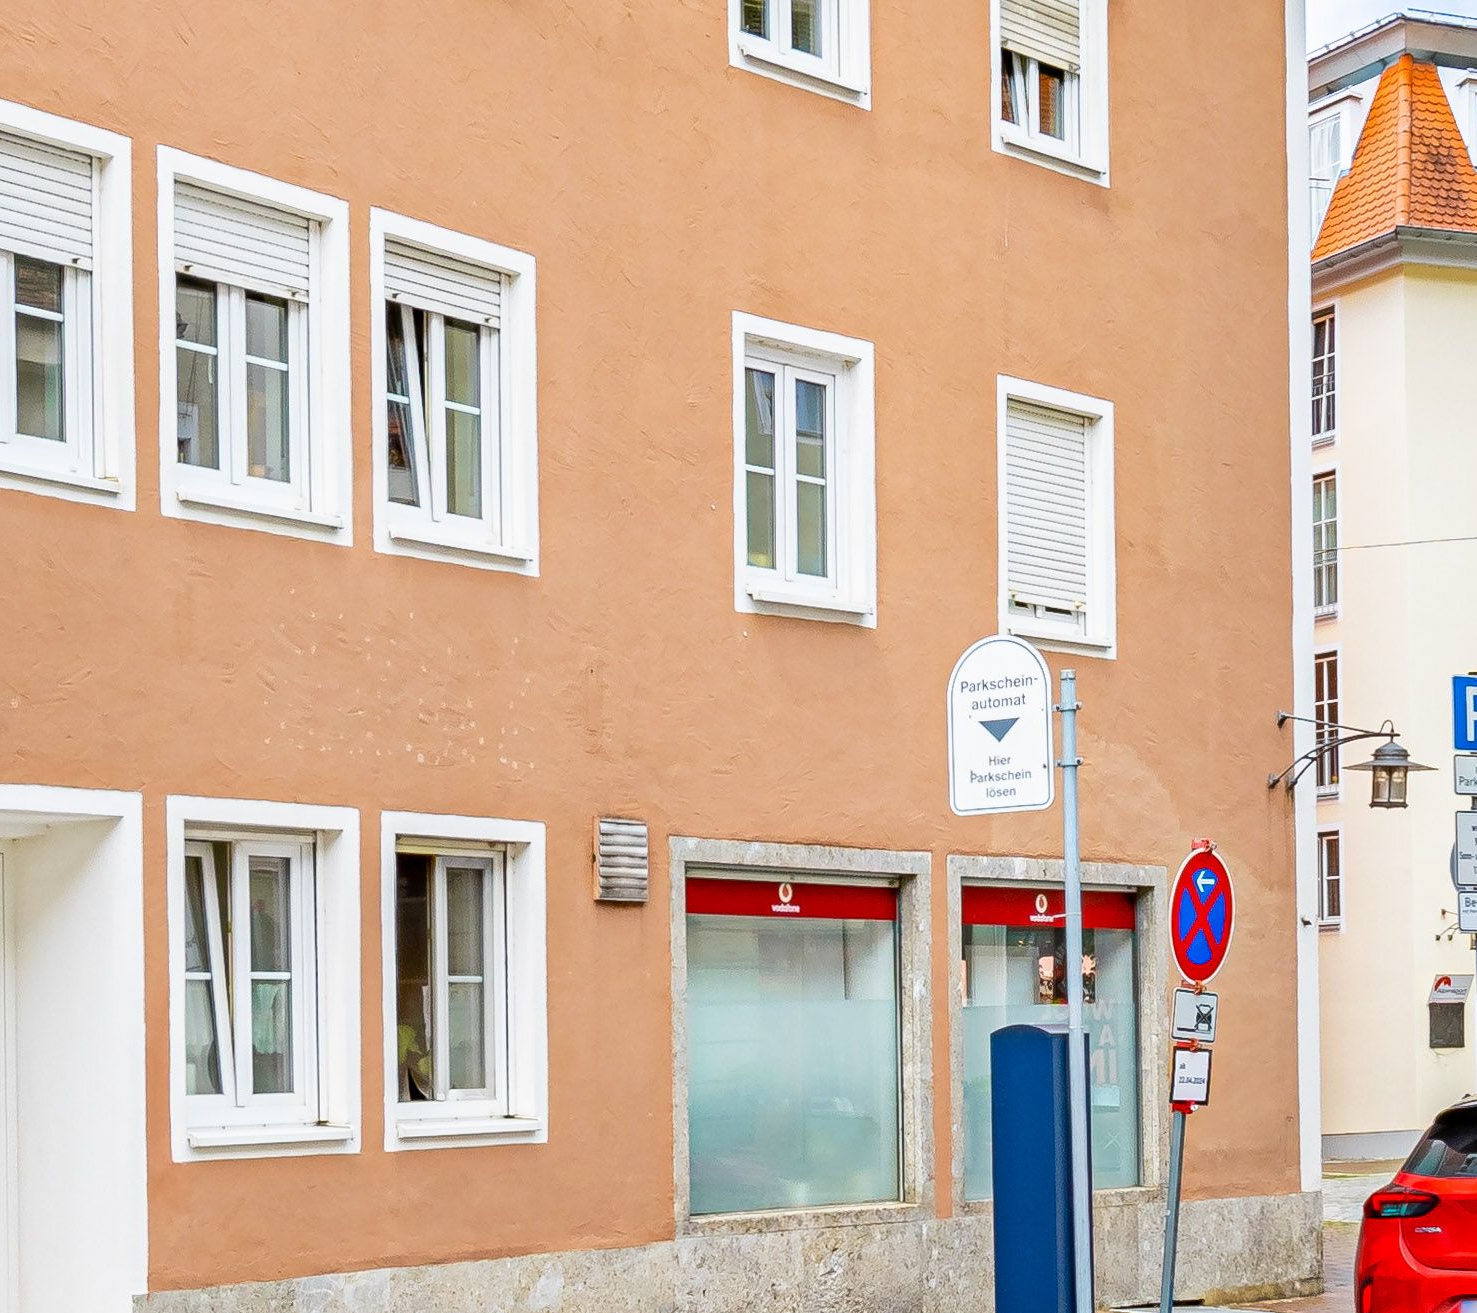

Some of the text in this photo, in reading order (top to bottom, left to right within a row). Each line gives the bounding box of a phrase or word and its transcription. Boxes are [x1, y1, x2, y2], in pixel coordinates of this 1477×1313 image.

[959, 675, 1039, 694] Parkschein-
[971, 693, 1026, 711] automat
[988, 755, 1012, 767] Hier
[969, 769, 1032, 784] Parkschein
[985, 786, 1017, 799] lösen
